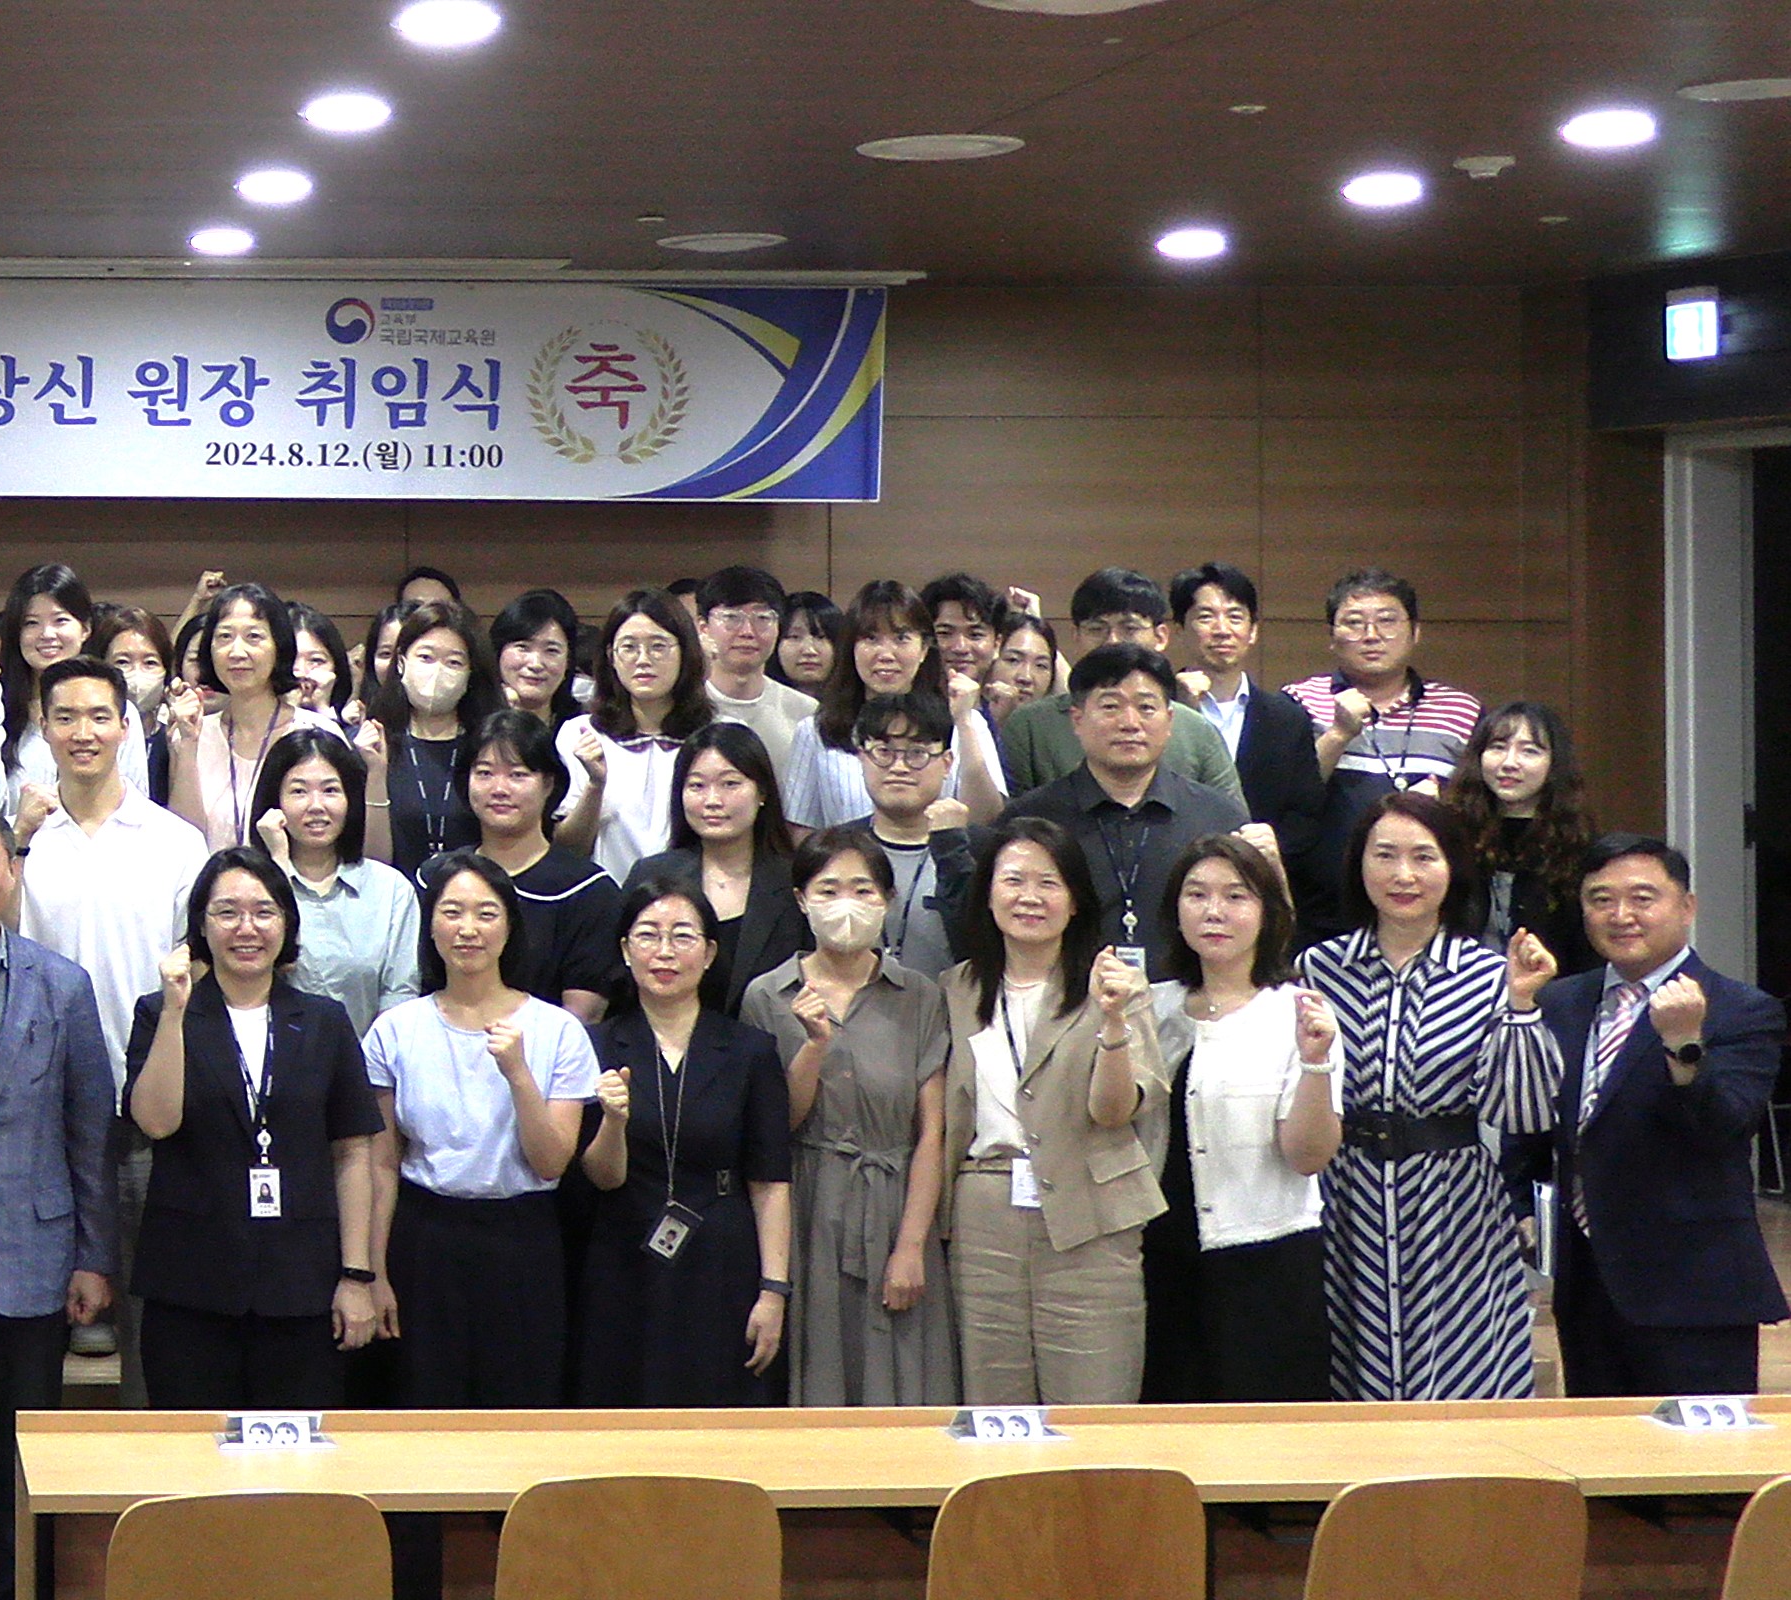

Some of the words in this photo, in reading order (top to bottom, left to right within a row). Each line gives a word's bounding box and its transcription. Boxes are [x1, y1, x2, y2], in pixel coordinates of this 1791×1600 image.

[380, 328, 496, 347] 국립국제교육원
[127, 356, 269, 430] 원장
[295, 357, 503, 433] 취임식
[564, 343, 648, 431] 축
[205, 441, 413, 471] 2024.8.12.(월)
[424, 444, 504, 469] 11:00
